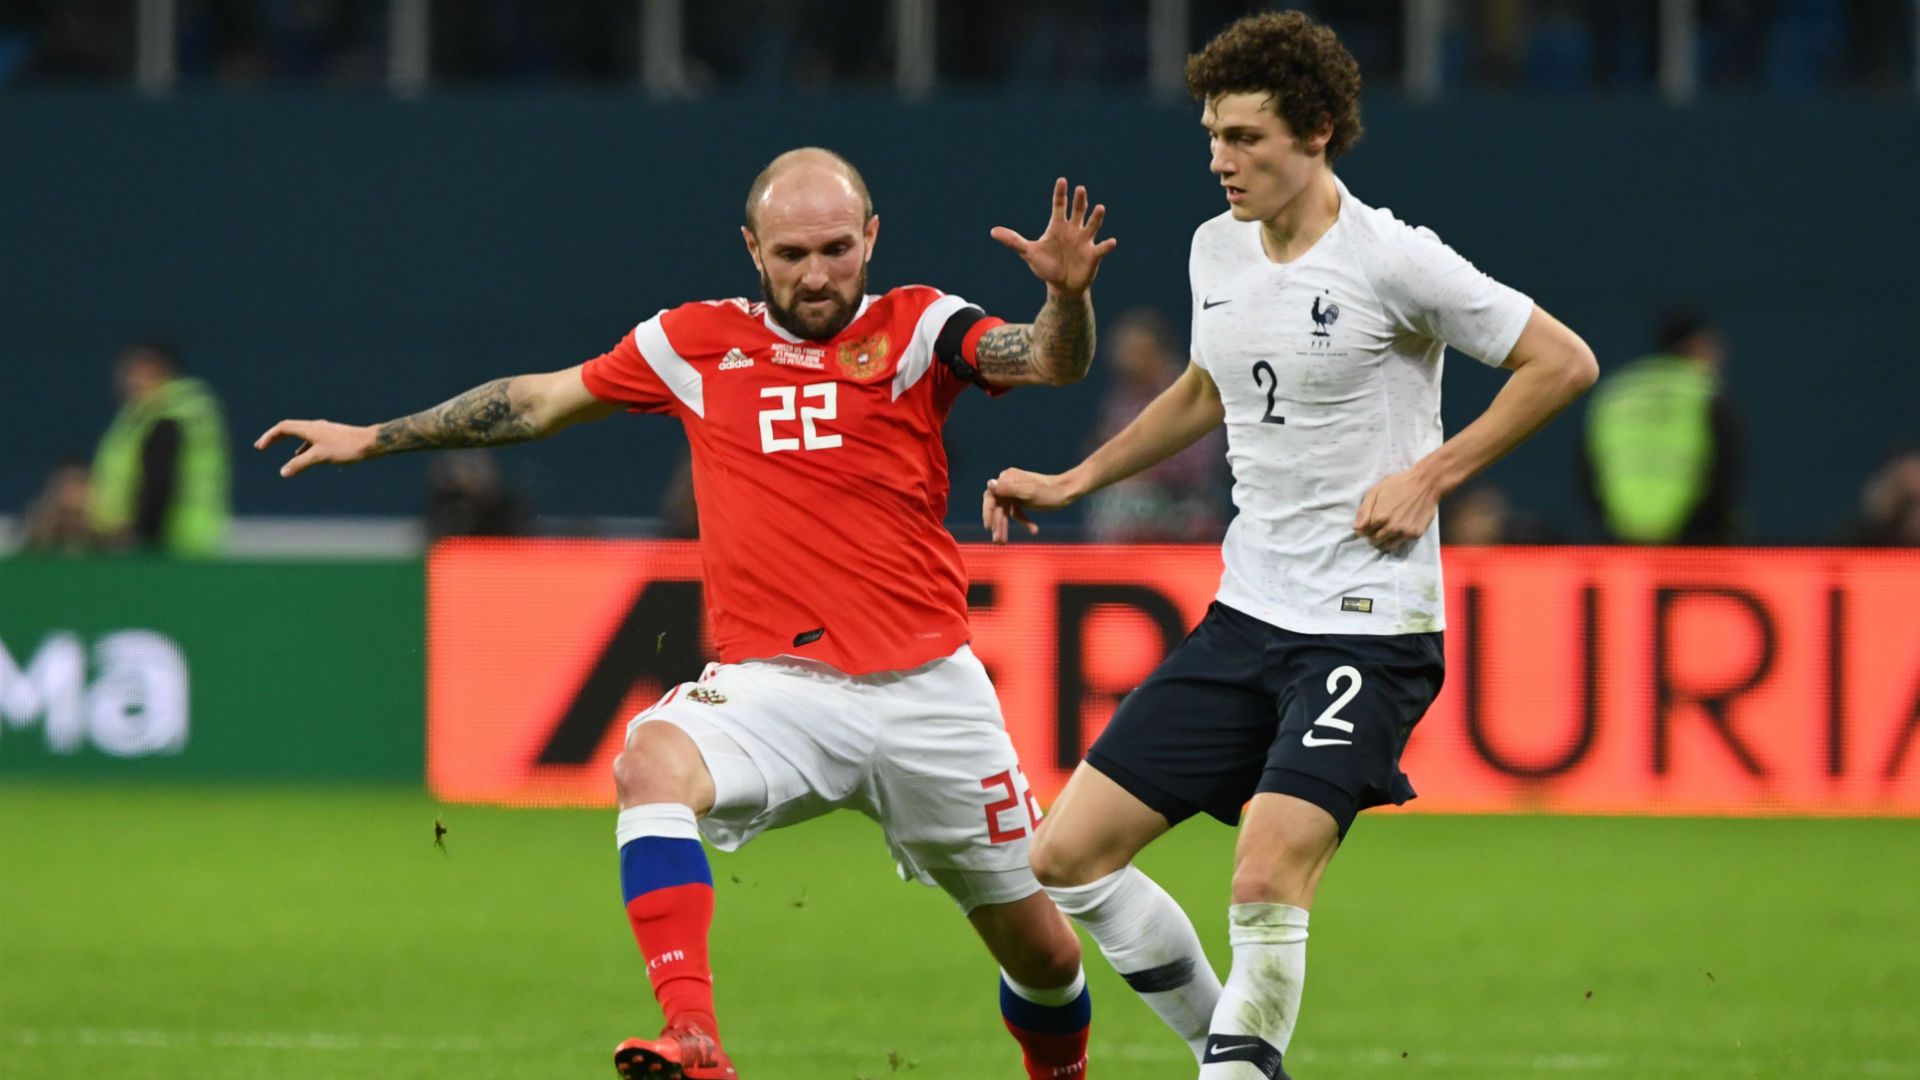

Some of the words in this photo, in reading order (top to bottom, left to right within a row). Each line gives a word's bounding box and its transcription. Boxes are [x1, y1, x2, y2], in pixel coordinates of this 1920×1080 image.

[718, 357, 754, 370] adidas
[1252, 360, 1285, 425] 2
[759, 382, 843, 454] 22
[1313, 665, 1363, 734] 2
